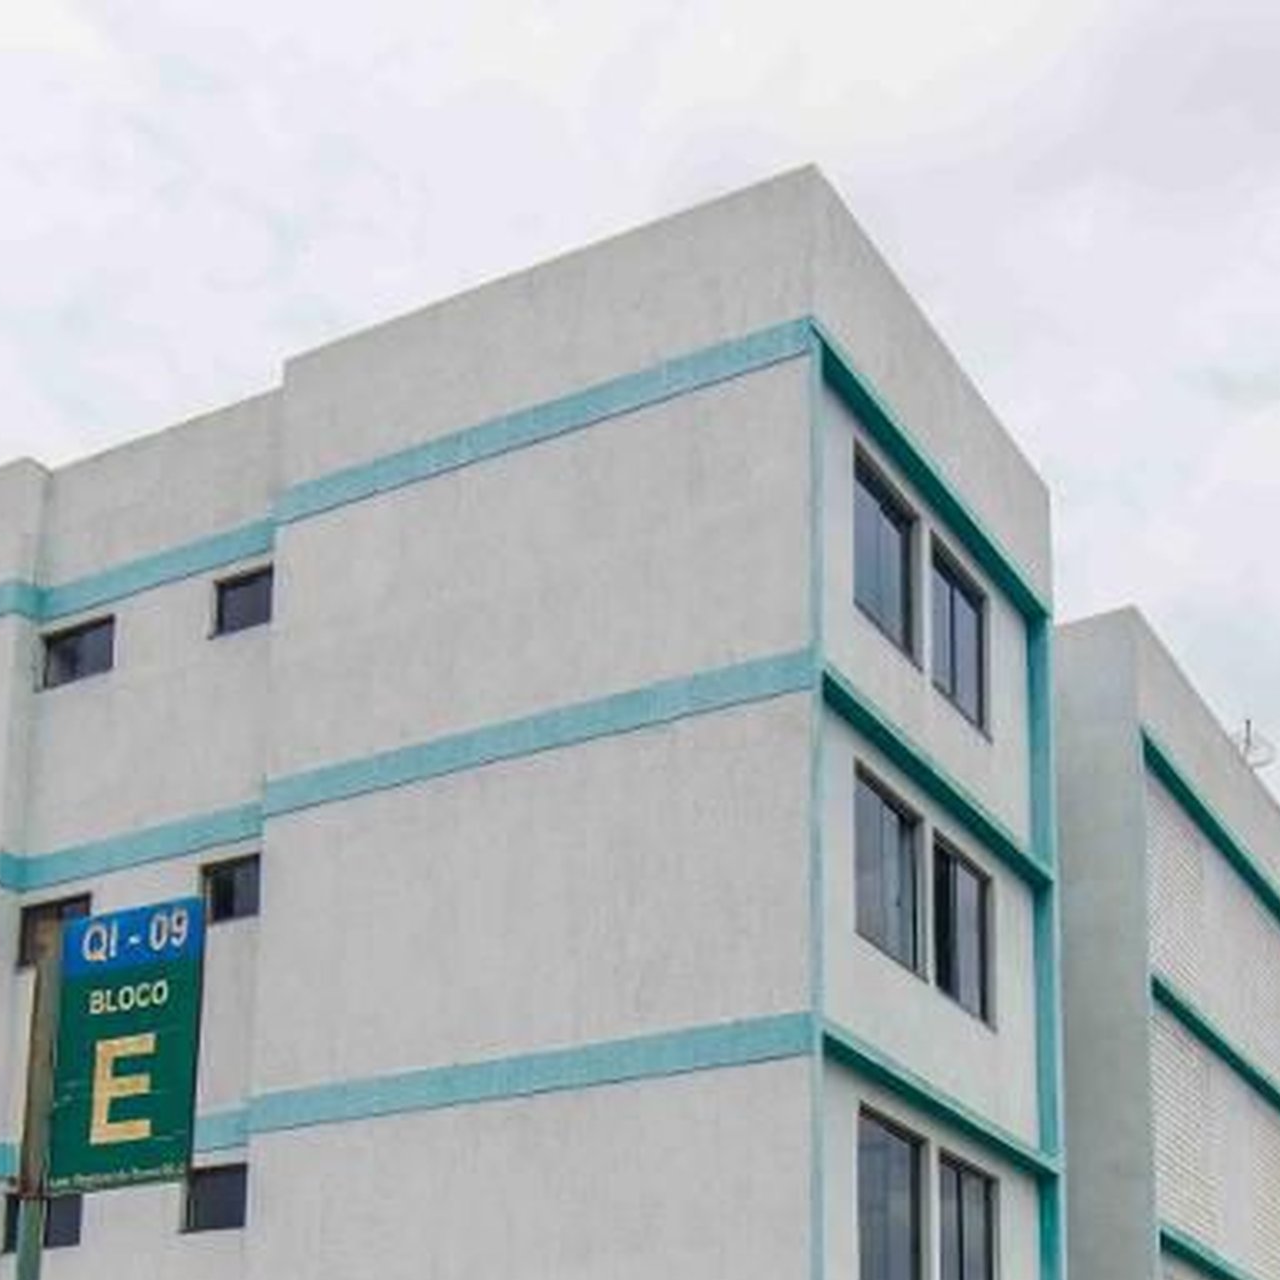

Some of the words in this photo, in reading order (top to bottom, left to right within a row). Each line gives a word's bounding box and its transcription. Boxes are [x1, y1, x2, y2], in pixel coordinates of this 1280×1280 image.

[83, 921, 118, 961] QI
[149, 909, 189, 950] 09
[88, 980, 169, 1014] BLOCO
[90, 1033, 155, 1145] E
